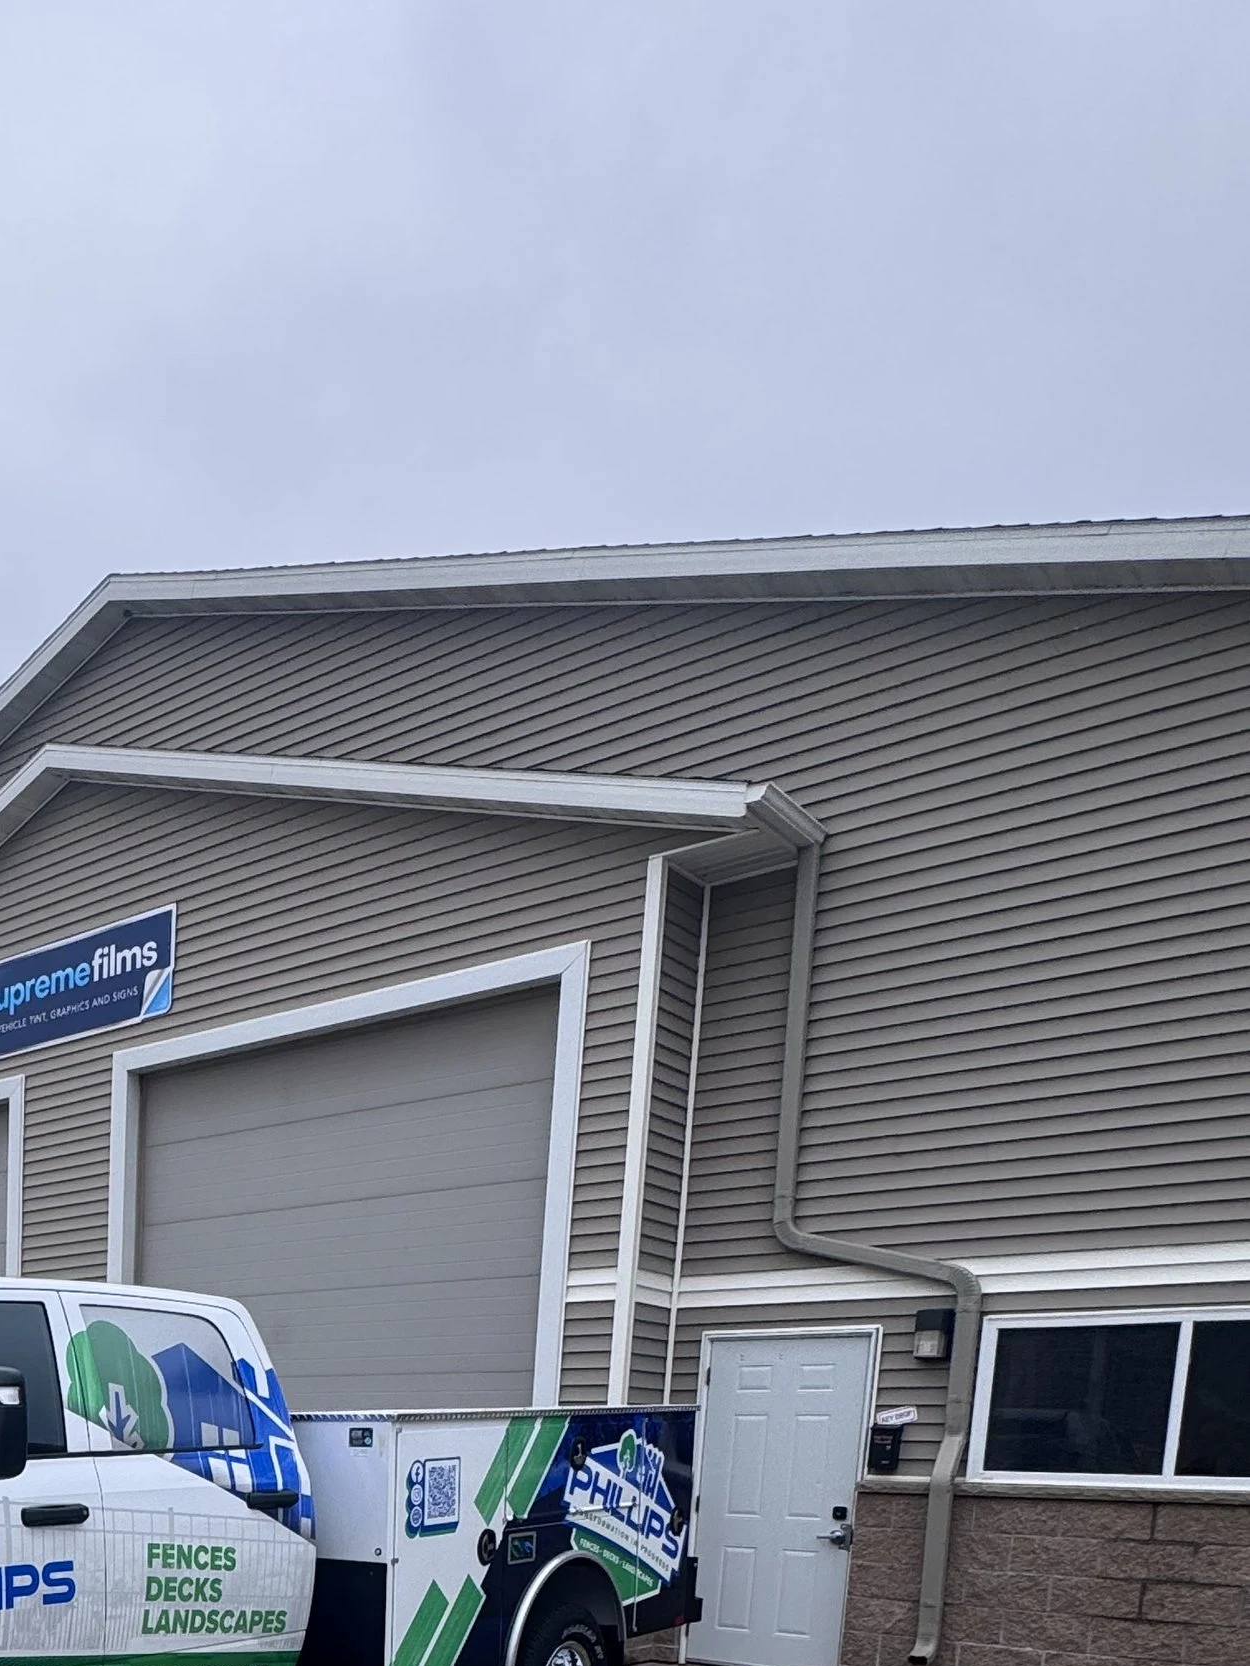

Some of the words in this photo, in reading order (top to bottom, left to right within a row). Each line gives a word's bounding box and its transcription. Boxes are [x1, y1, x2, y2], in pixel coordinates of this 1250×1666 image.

[29, 1012, 48, 1024] TINT,
[50, 1000, 89, 1020] GRAPHICS
[91, 997, 111, 1008] AND
[112, 986, 139, 1002] SIGNS
[569, 1462, 680, 1560] PHILLIPS
[147, 1543, 237, 1572] FENCES
[579, 1538, 600, 1554] FENCES
[602, 1549, 620, 1565] DECKS
[640, 1544, 670, 1572] PROGRESS
[145, 1576, 223, 1603] DECKS
[141, 1609, 288, 1635] LANDSCAPES
